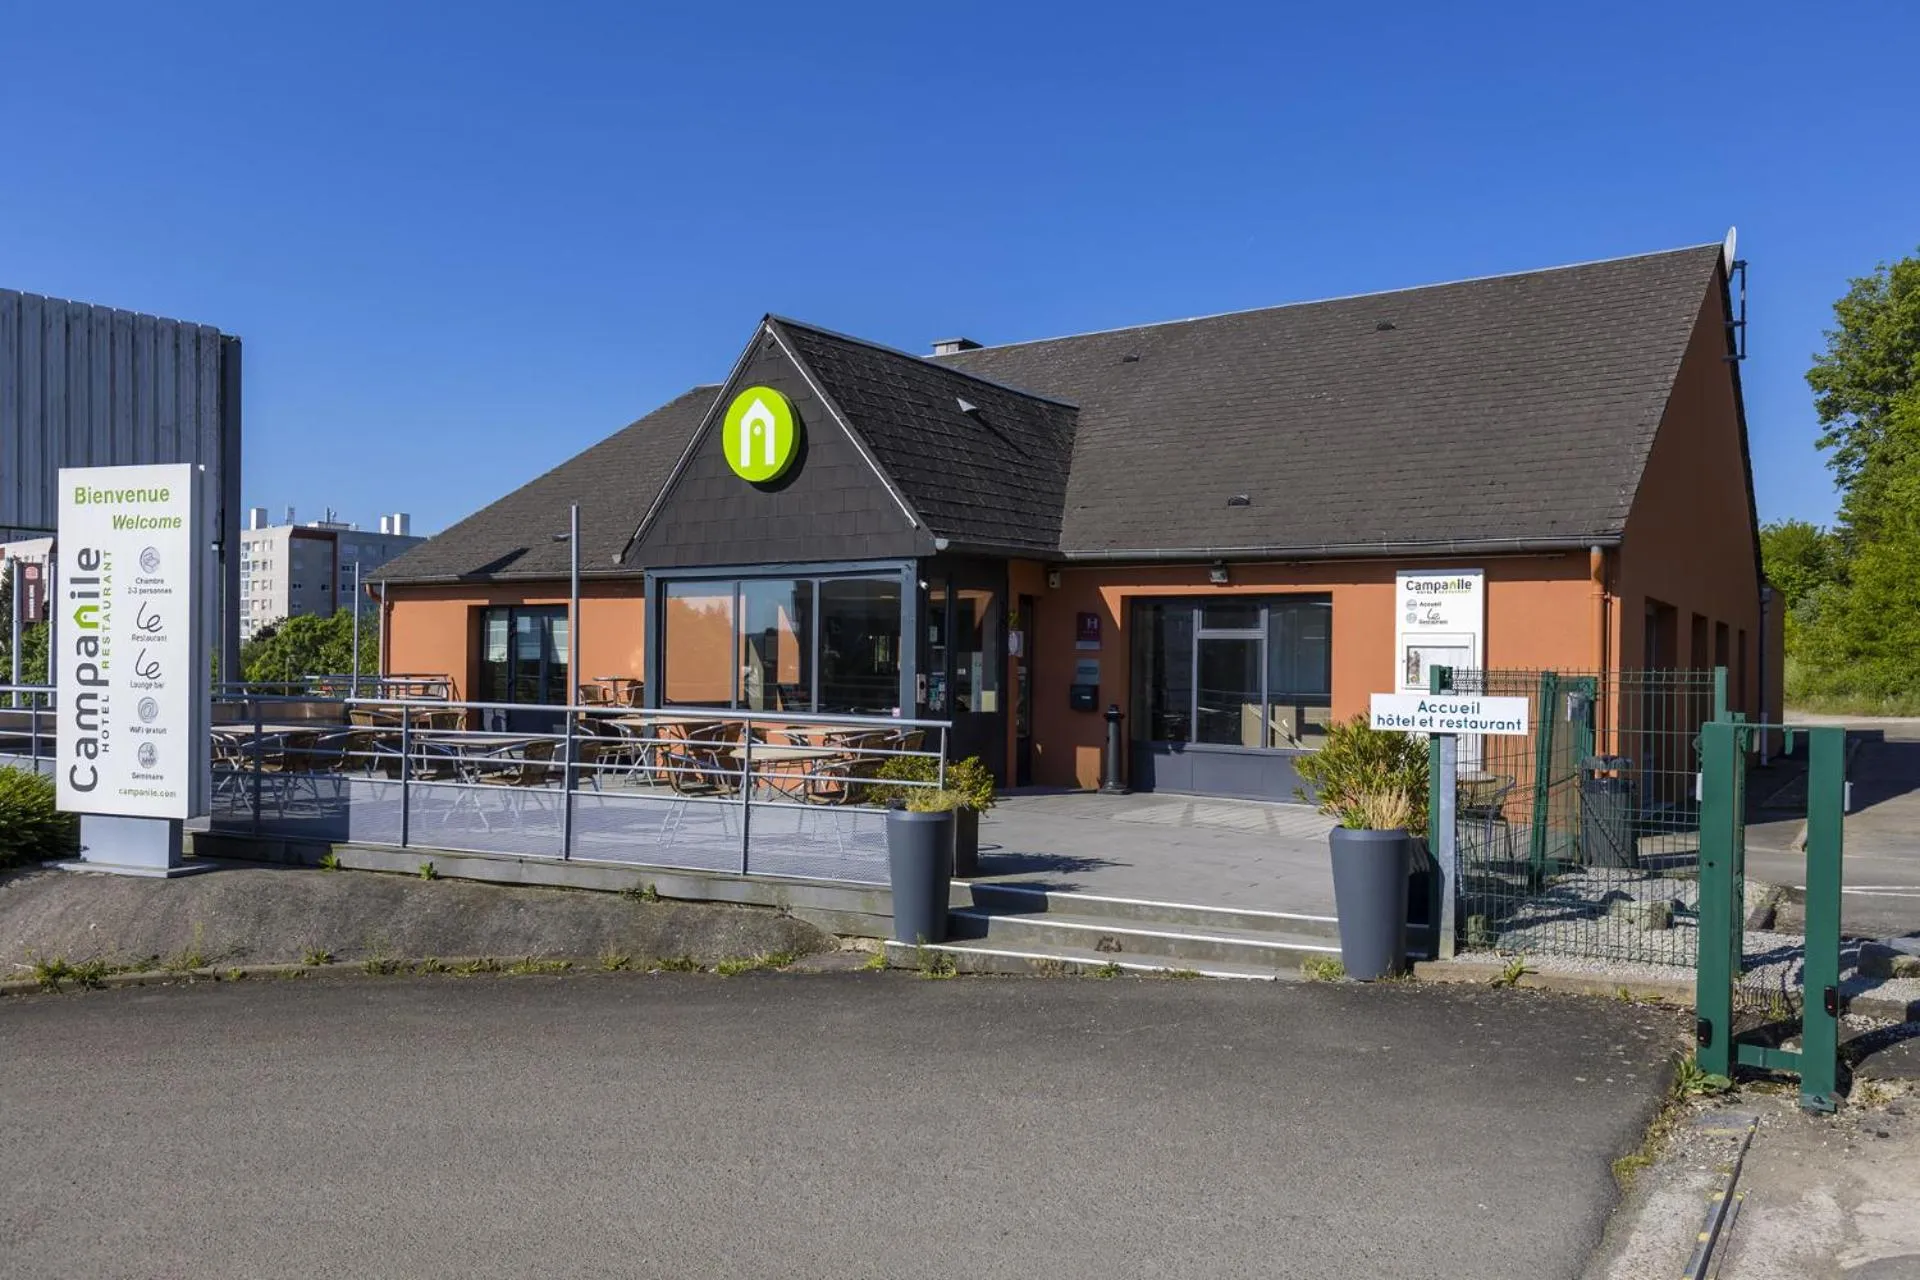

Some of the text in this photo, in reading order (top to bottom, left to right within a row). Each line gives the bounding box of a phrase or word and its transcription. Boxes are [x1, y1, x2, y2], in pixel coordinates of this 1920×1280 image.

[74, 486, 170, 504] Bienvenue
[113, 514, 182, 530] Welcome
[101, 551, 112, 753] HOTEL RESTAURANT
[69, 547, 109, 793] Campanile
[1417, 700, 1481, 715] Accueil
[1376, 714, 1522, 732] hôtel et restaurant
